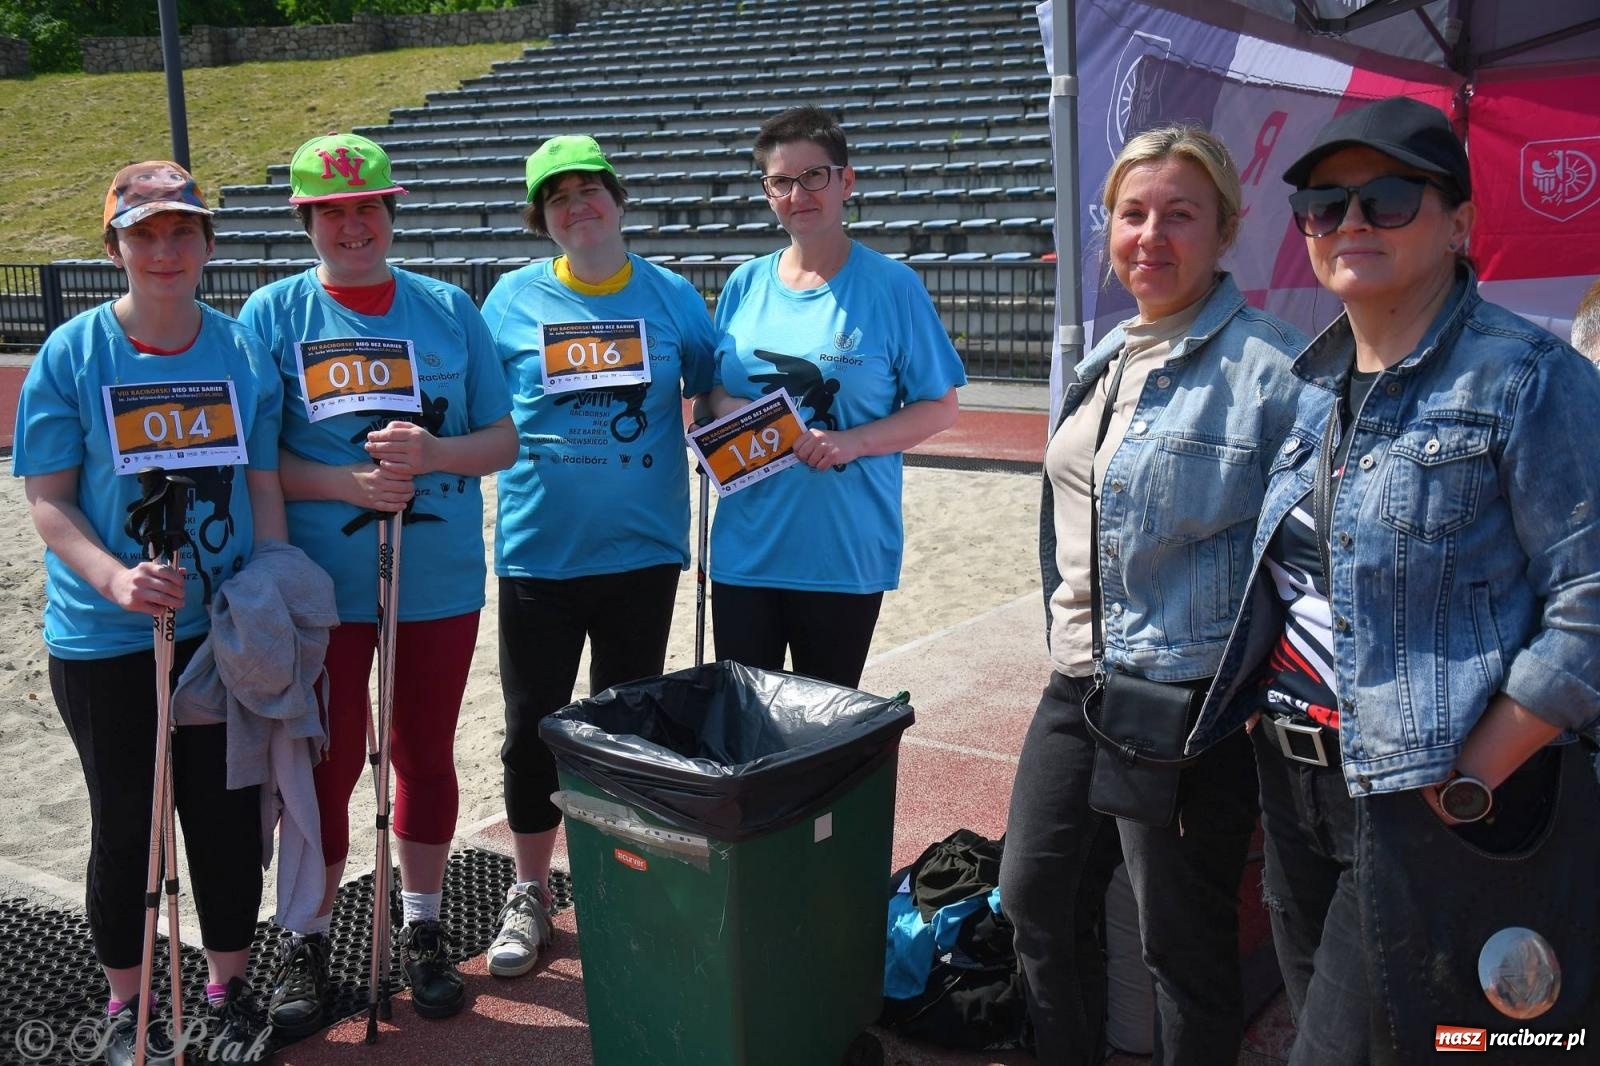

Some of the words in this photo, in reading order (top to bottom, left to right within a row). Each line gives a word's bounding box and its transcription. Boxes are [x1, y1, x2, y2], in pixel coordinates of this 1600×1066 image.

[318, 147, 366, 186] NY
[567, 342, 620, 367] 016
[820, 354, 864, 366] Racibórz
[328, 360, 390, 388] 010
[419, 372, 460, 382] Racibórz
[575, 391, 614, 408] VIII
[570, 410, 610, 418] RACIBORSKI
[143, 408, 211, 442] 014
[728, 428, 780, 467] 149
[562, 455, 608, 465] Racibórz
